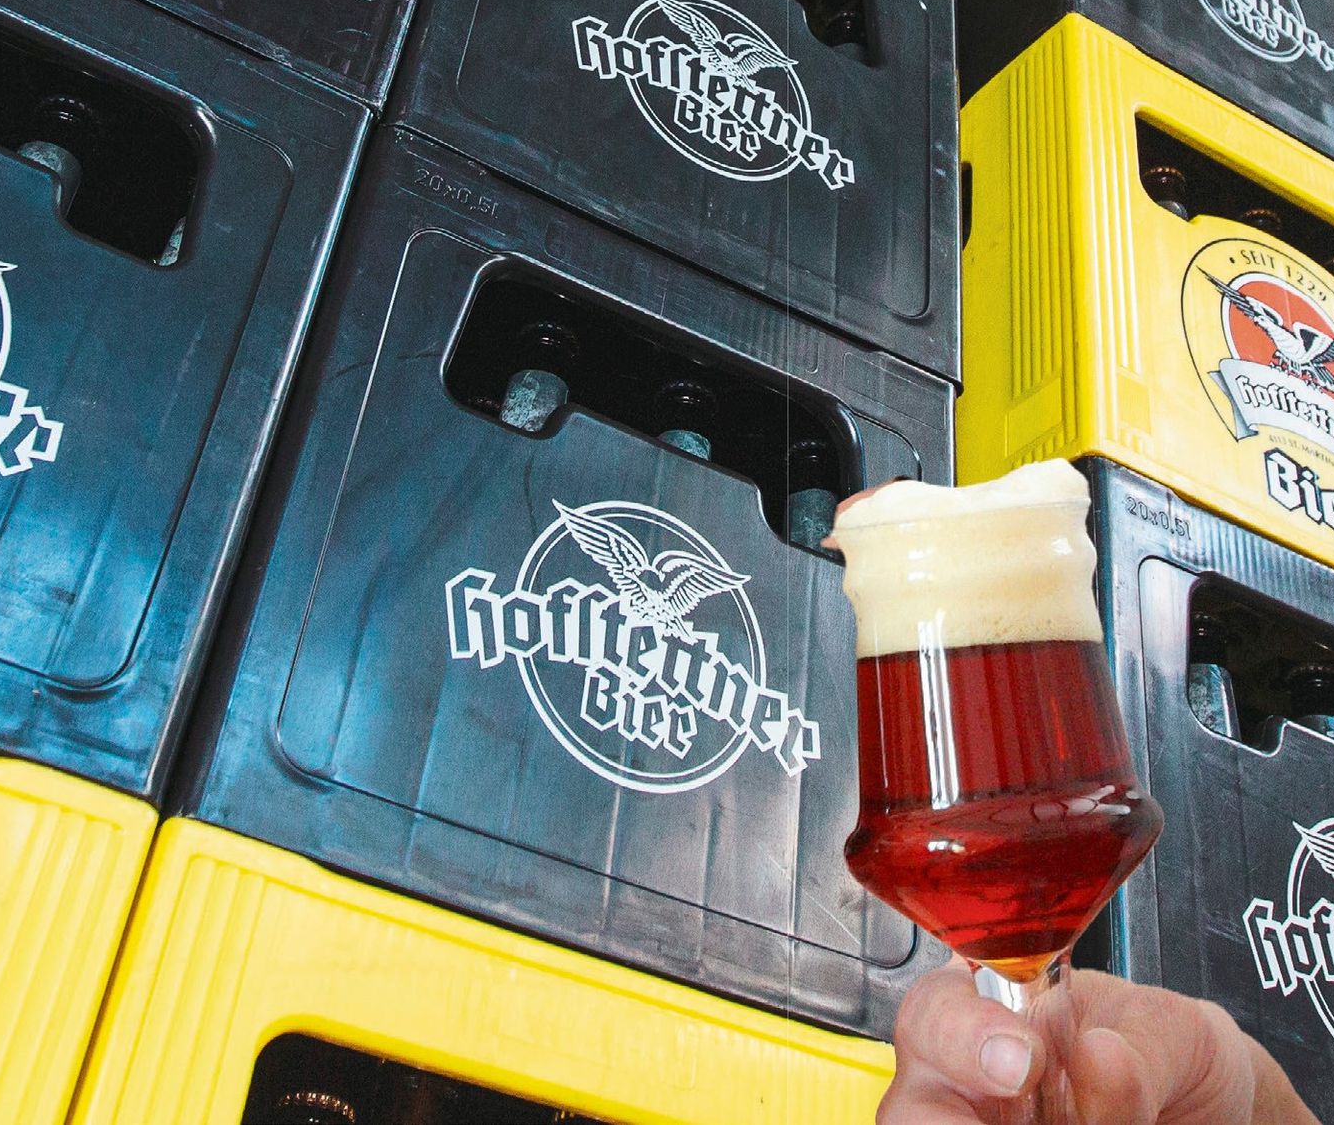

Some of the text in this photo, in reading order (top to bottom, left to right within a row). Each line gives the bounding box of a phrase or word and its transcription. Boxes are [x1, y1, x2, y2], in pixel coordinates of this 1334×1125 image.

[674, 92, 762, 163] Bier
[1240, 249, 1327, 302] SEIT 1229
[580, 665, 698, 759] Bier
